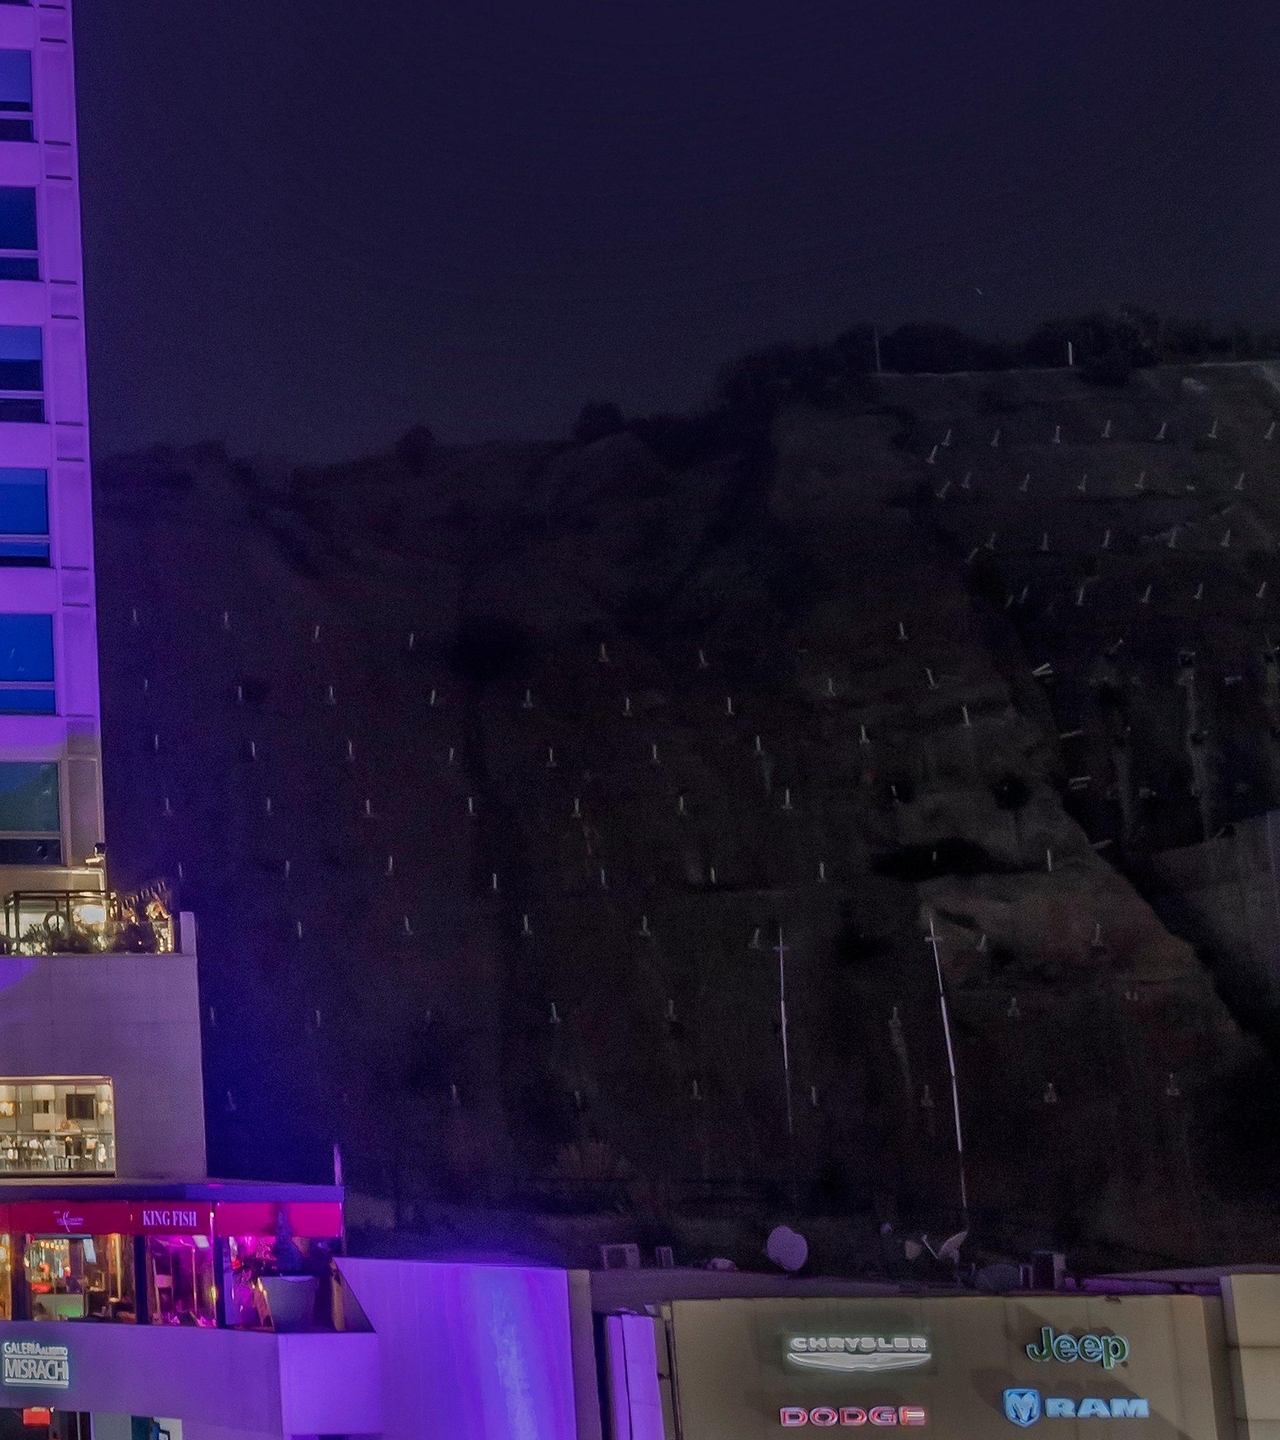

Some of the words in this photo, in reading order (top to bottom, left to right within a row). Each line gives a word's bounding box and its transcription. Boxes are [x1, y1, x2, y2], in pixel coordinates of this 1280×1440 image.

[142, 1210, 170, 1226] KING
[172, 1210, 197, 1227] FISH
[790, 1336, 928, 1352] CHRYSLER
[1026, 1326, 1130, 1370] Jeep
[4, 1358, 70, 1380] MISRACHI
[779, 1405, 926, 1428] DODGE
[1044, 1396, 1150, 1419] RAM
